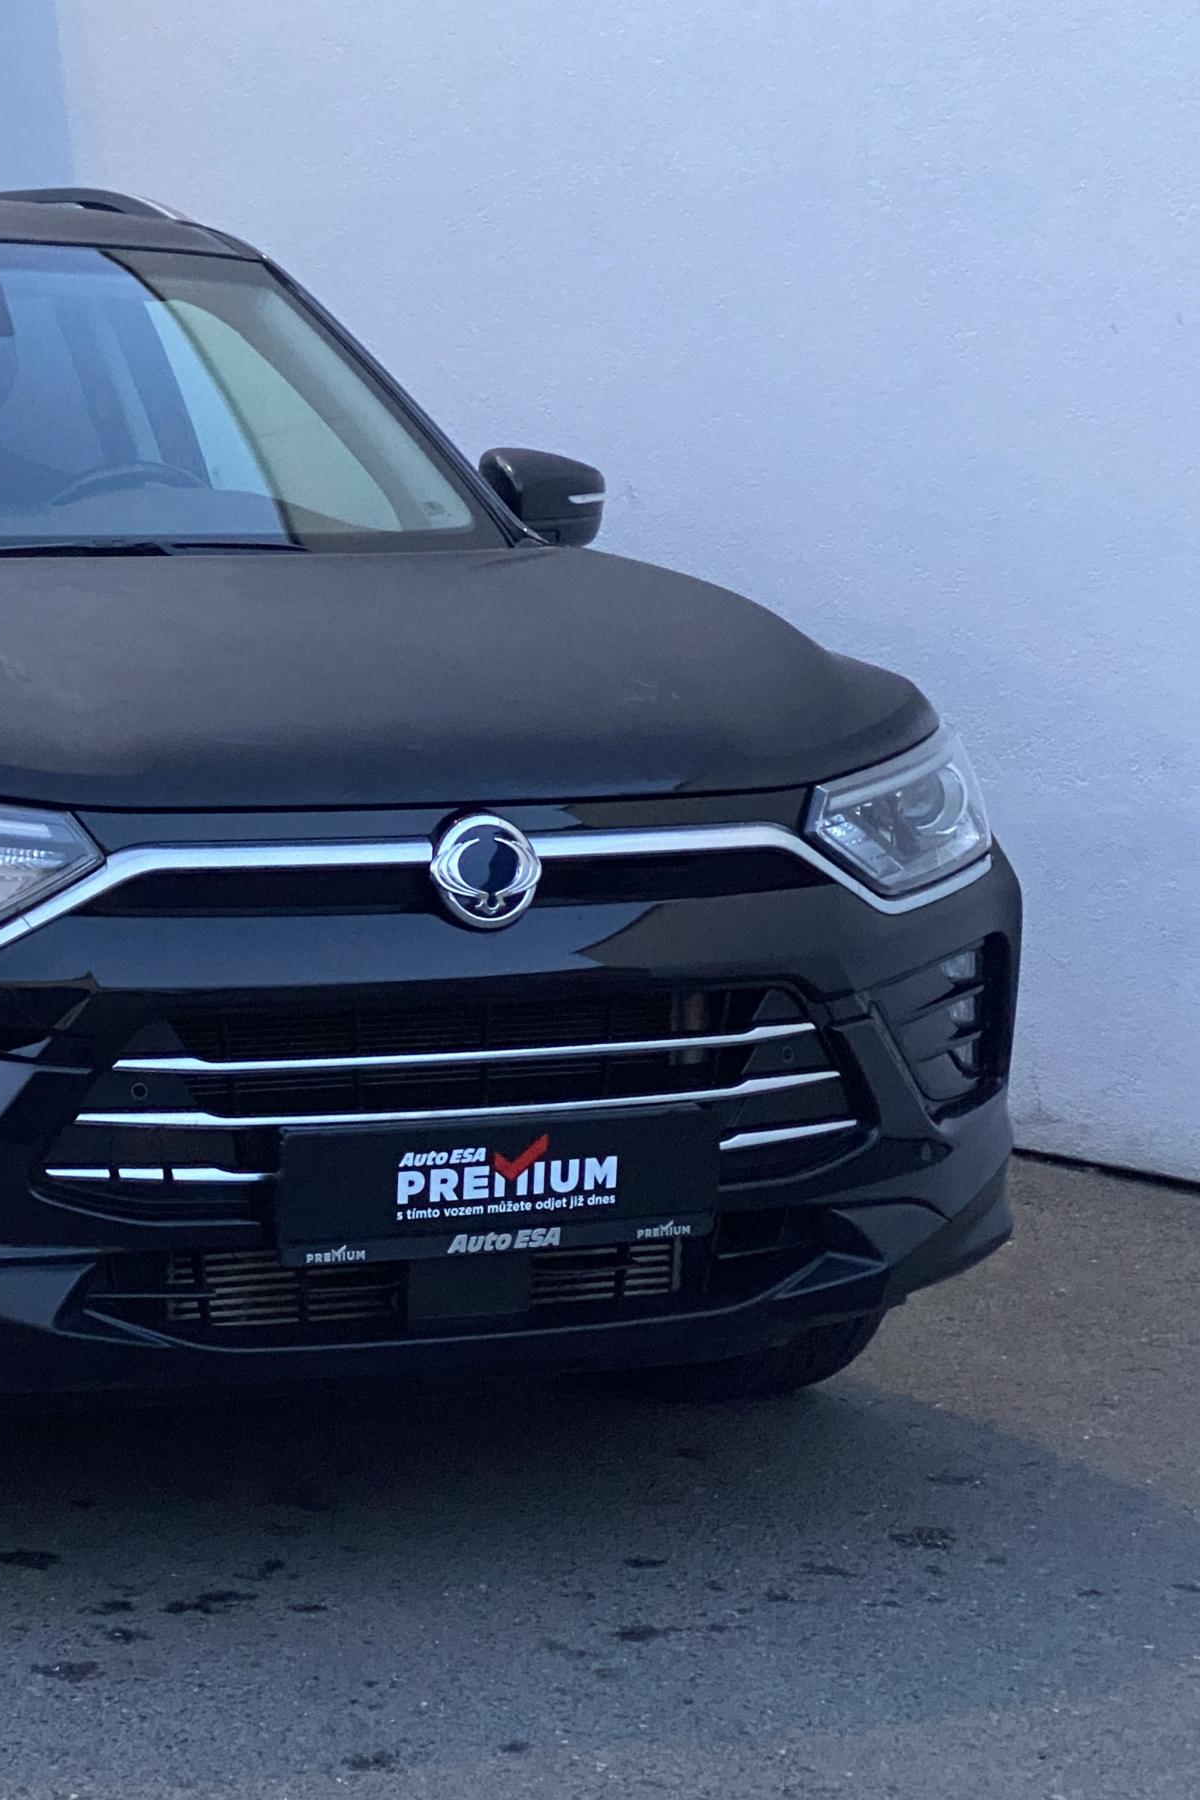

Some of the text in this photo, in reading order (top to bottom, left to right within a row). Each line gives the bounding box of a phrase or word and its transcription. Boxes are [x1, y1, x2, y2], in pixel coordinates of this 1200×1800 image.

[399, 1147, 487, 1167] Auto ESA
[397, 1150, 618, 1204] PREMIUM
[396, 1193, 616, 1221] s tímto vozem můžete odjet již dnes
[447, 1227, 561, 1254] Auto ESA
[636, 1221, 691, 1239] PREMIUM
[305, 1246, 367, 1263] PREMIUM
